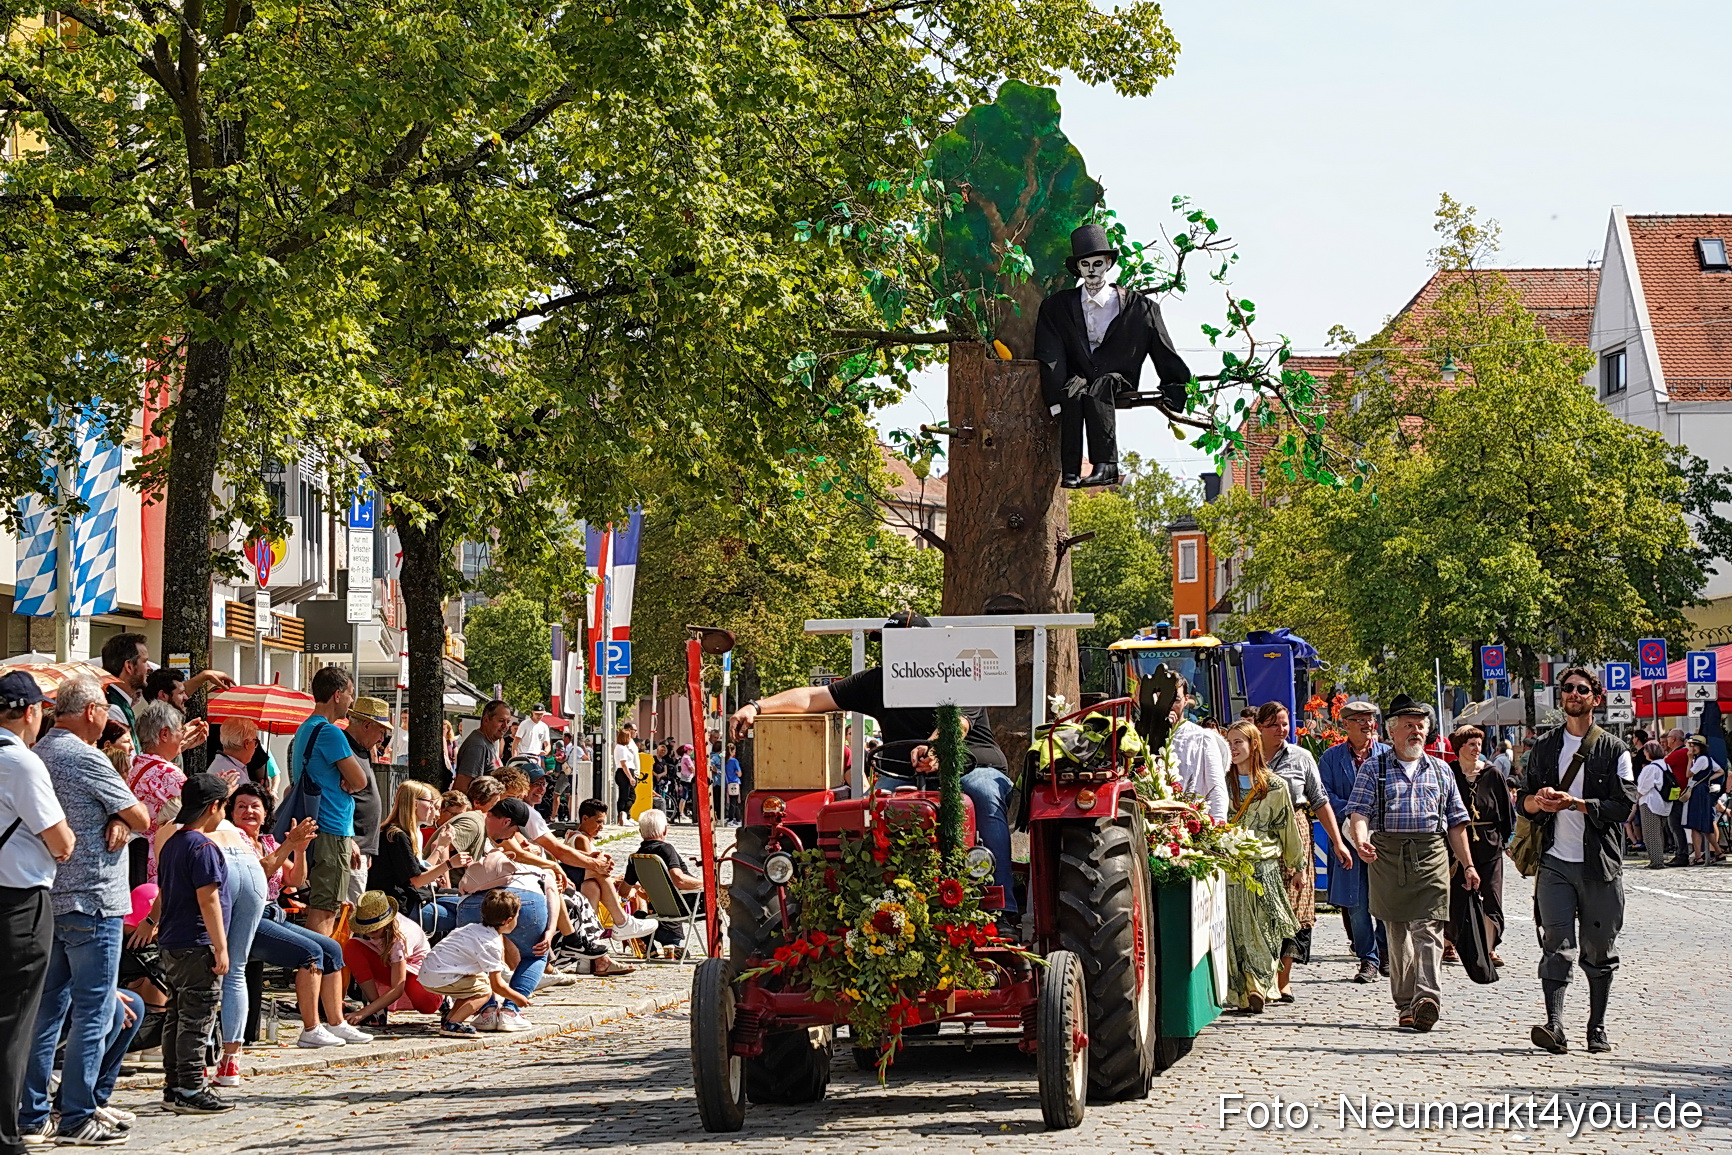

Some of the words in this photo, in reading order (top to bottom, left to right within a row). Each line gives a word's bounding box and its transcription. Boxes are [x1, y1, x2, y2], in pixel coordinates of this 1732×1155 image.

[306, 643, 348, 651] ESPRIT
[606, 647, 622, 671] P
[1693, 655, 1710, 679] P
[891, 661, 972, 683] Schloss-Spiele
[1484, 668, 1504, 677] TAXI
[1611, 666, 1626, 688] P
[1642, 667, 1665, 677] TAXI
